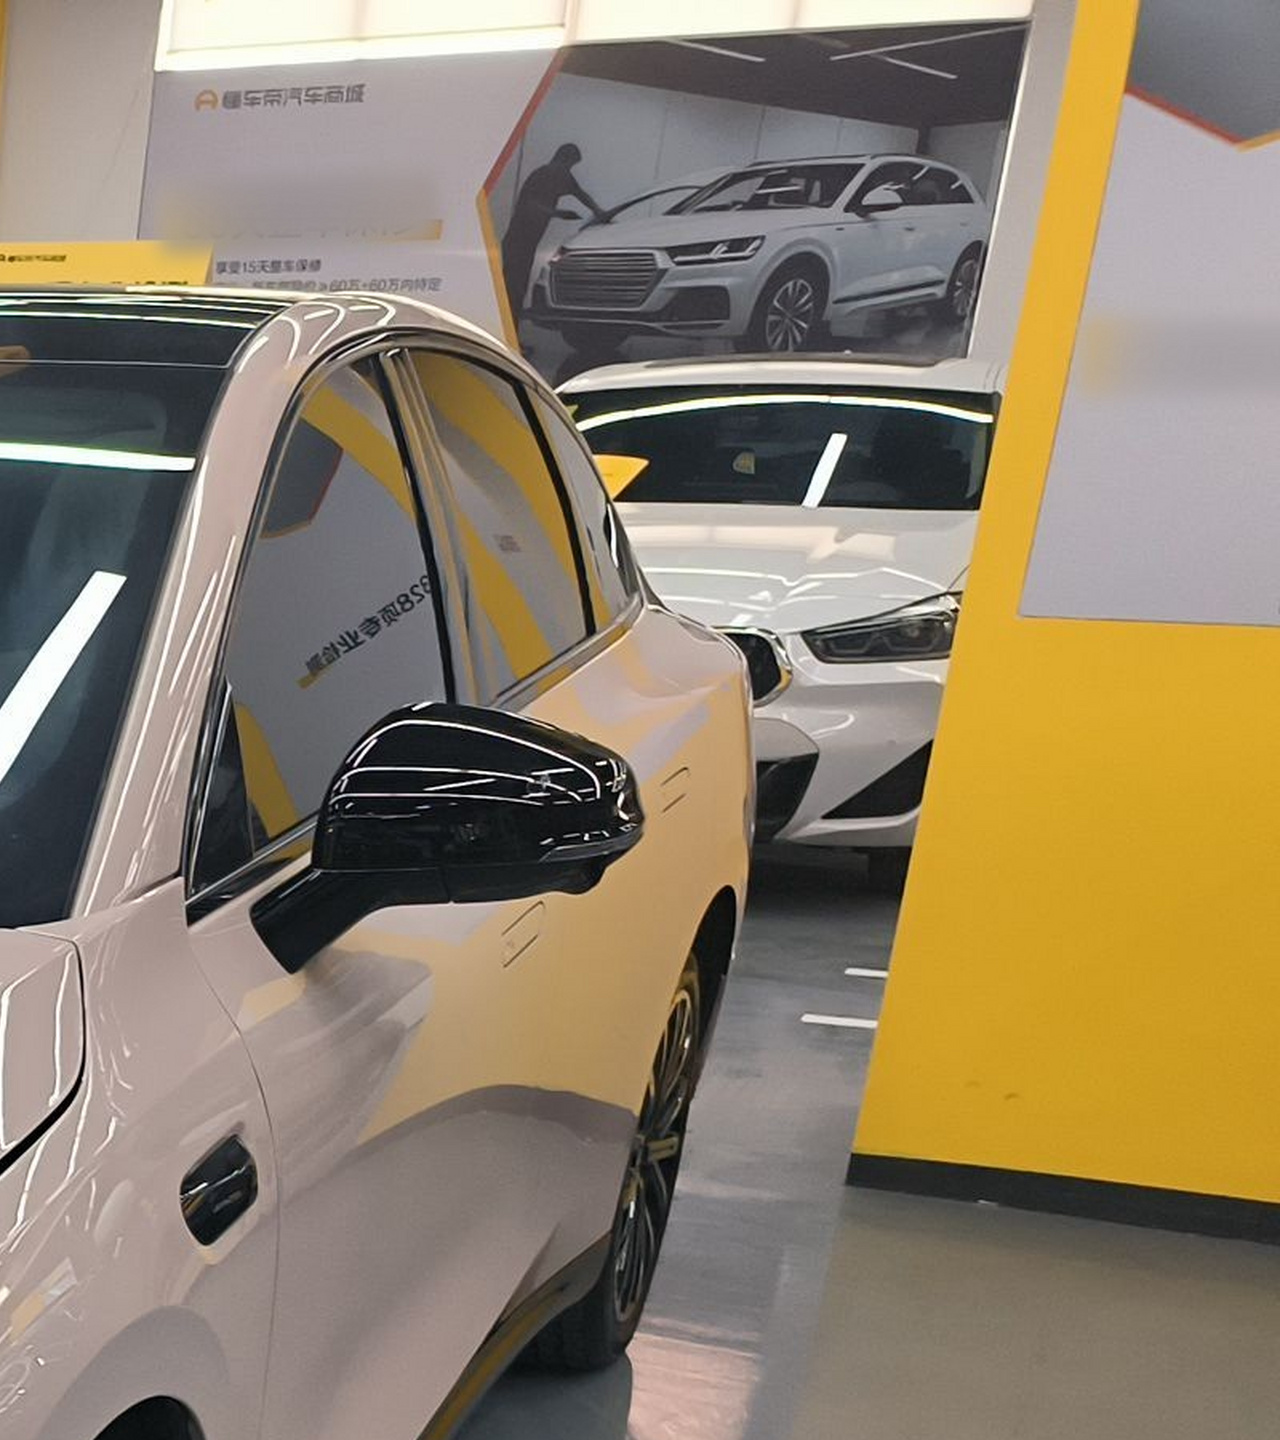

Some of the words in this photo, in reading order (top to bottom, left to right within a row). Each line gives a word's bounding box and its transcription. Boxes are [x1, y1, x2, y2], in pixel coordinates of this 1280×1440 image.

[222, 84, 366, 109] 懂车帝汽车商城
